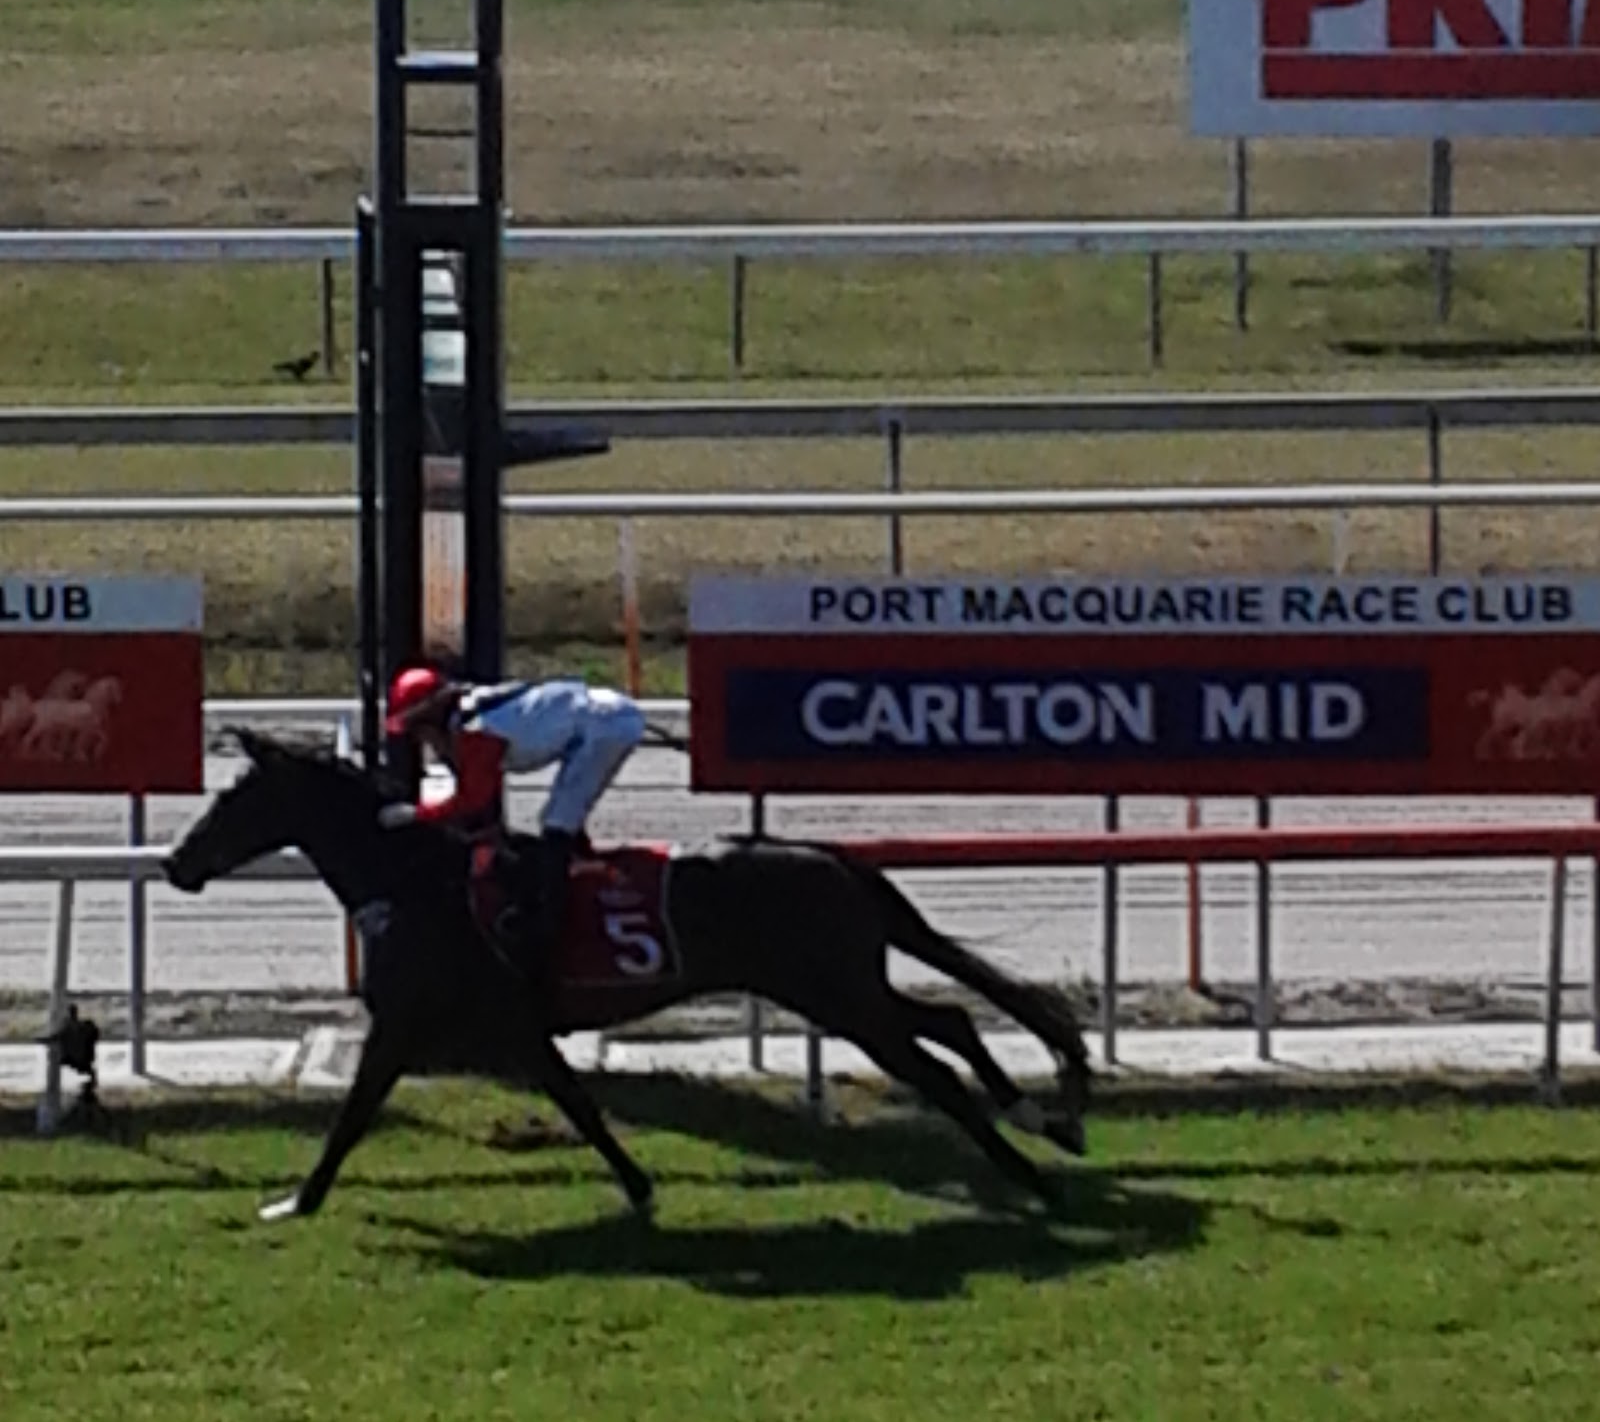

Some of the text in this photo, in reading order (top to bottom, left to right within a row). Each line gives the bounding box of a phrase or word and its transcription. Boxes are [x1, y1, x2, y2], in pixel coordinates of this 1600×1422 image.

[810, 586, 1573, 624] PORT MACQUARIE RACE CLUB
[803, 681, 1364, 744] CARLTON MID
[604, 913, 661, 975] 5
